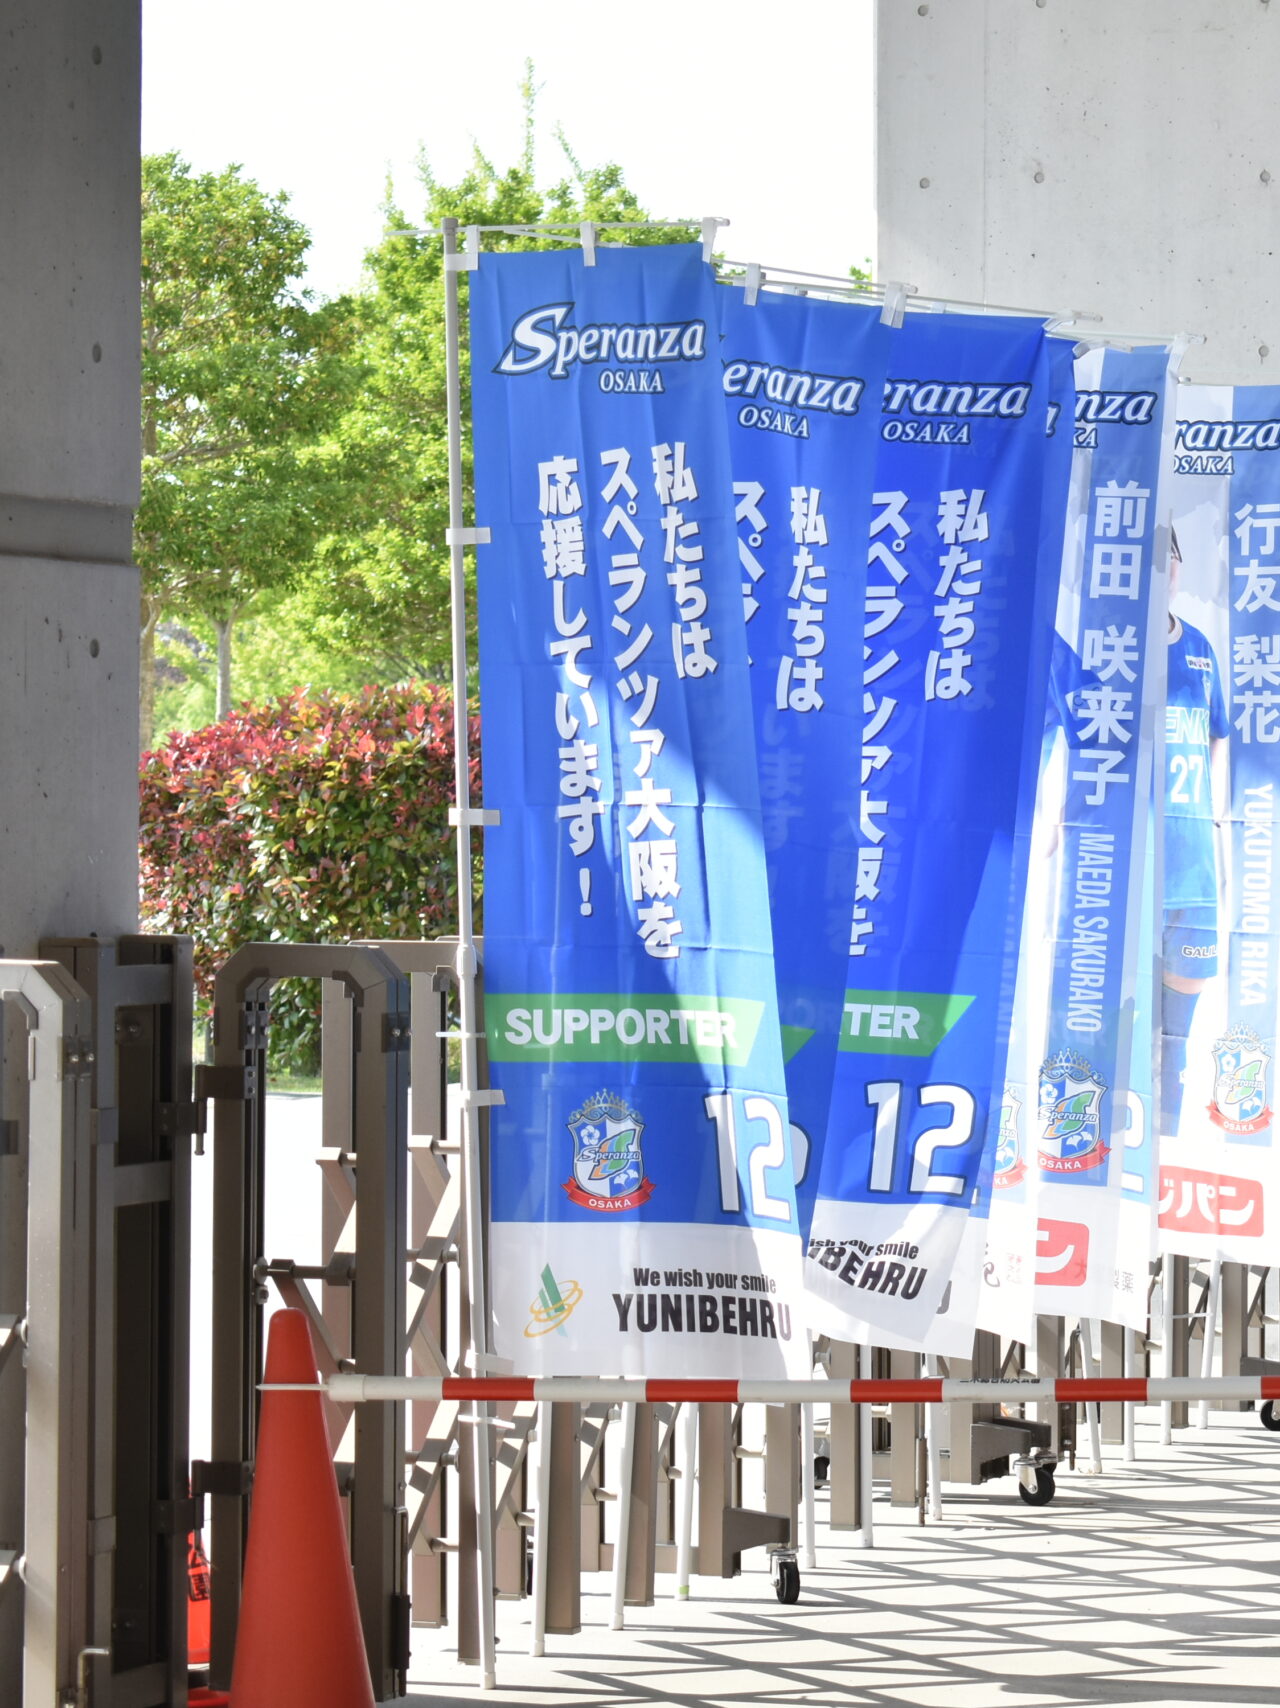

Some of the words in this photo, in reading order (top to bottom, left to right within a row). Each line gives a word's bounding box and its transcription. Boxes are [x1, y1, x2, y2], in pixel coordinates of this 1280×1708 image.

[494, 302, 706, 379] Speranza
[599, 370, 666, 393] OSAKA
[722, 358, 863, 414] eranza
[883, 380, 1031, 417] ranza
[738, 403, 811, 439] OSAKA
[882, 420, 971, 444] OSAKA
[651, 441, 718, 679] 私たちは
[1089, 480, 1150, 601] 前田
[776, 485, 828, 712] 私たちは
[924, 487, 990, 701] 私たちは
[537, 455, 604, 916] 応援しています！
[600, 446, 683, 959] スペランツァ大阪を
[1072, 624, 1141, 806] 咲来子
[1170, 755, 1204, 804] 27
[1074, 832, 1115, 909] MAEDA
[1241, 782, 1273, 934] YUKUTOMO
[1066, 914, 1110, 1033] SAKURAKO
[1239, 940, 1269, 1007] RIKA
[504, 1006, 738, 1050] SUPPORTER
[865, 1079, 976, 1196] 12
[1223, 1121, 1255, 1132] OSAKA
[577, 1145, 642, 1165] Speranza
[704, 1090, 793, 1222] 12
[1038, 1157, 1082, 1170] OSAKA
[588, 1198, 632, 1209] OSAKA
[808, 1246, 928, 1300] BEHRU
[875, 1241, 920, 1260] smile
[633, 1267, 661, 1287] We
[664, 1268, 703, 1289] wish
[706, 1271, 738, 1291] your
[741, 1273, 777, 1294] smile
[612, 1292, 792, 1342] YUNIBEHRU
